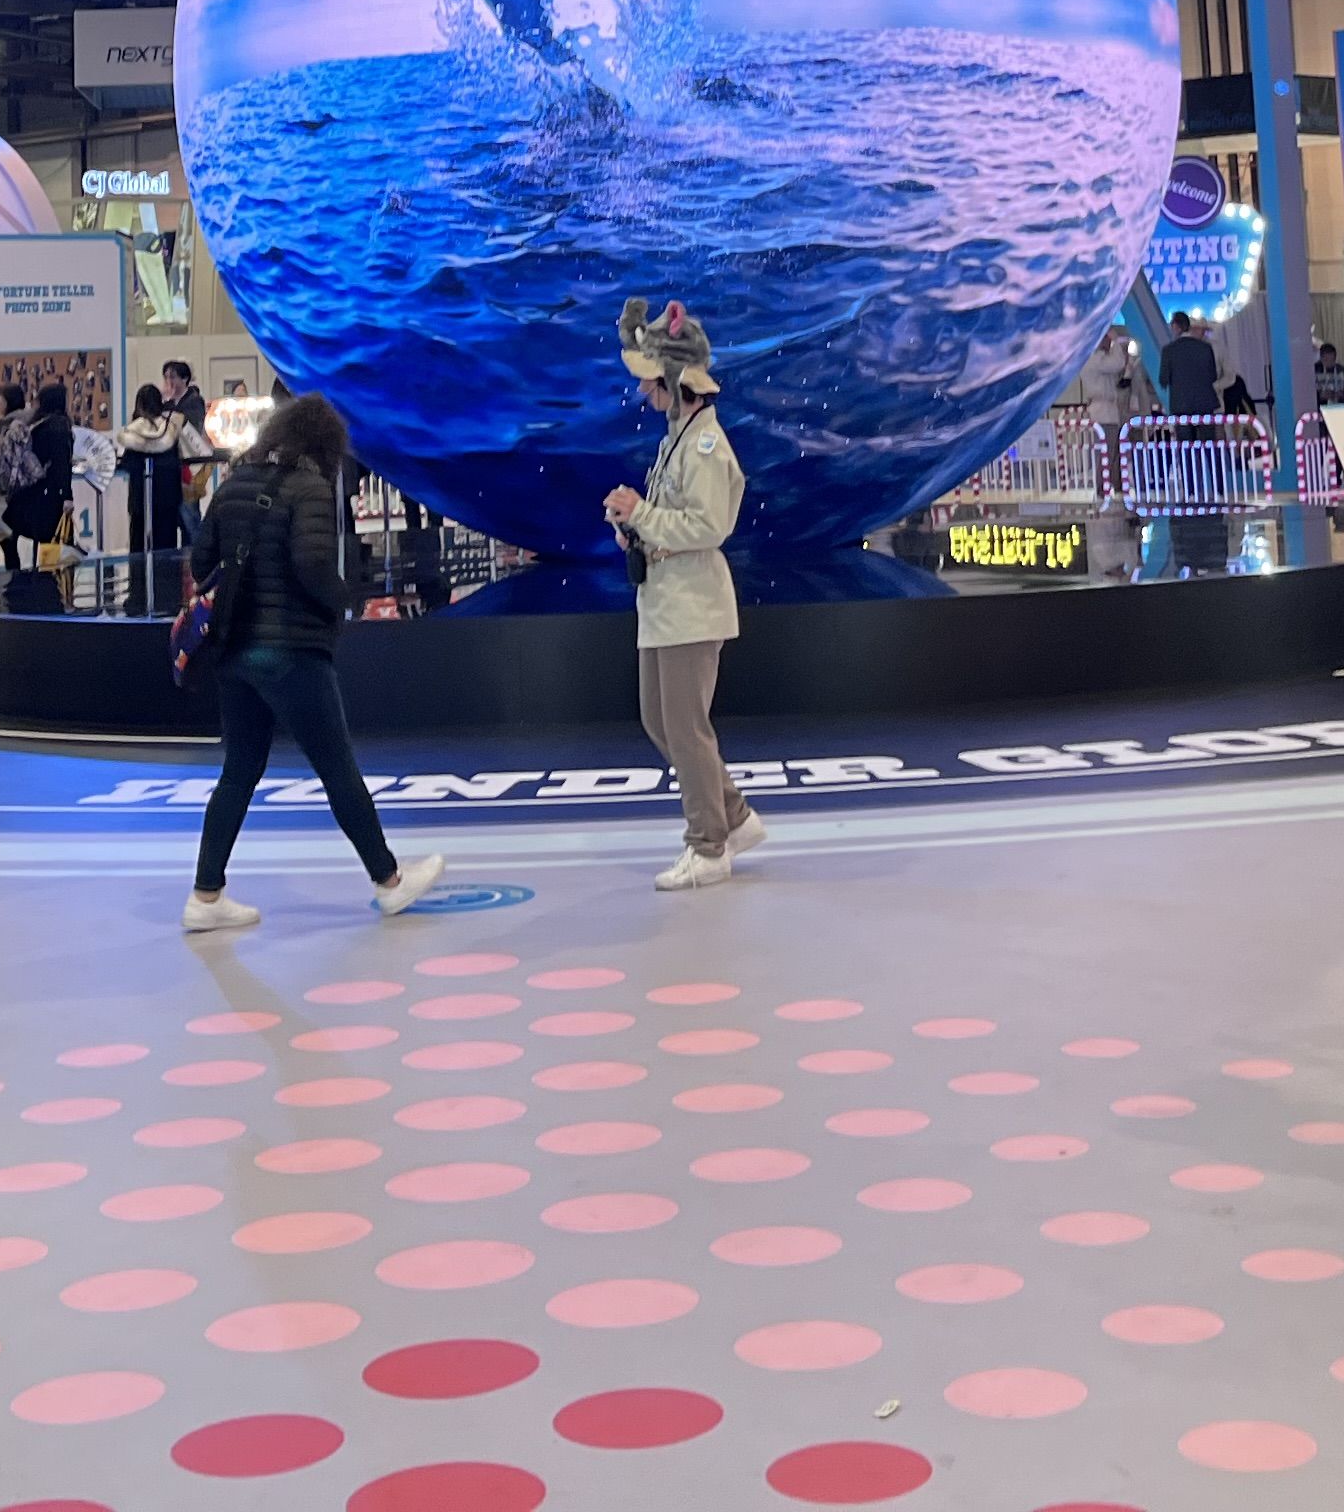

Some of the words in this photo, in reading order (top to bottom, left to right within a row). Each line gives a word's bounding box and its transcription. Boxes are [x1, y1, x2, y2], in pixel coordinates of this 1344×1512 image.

[82, 170, 107, 198] CJ
[108, 170, 170, 195] Global
[51, 284, 95, 297] TELLER
[4, 301, 39, 314] PHOTO
[41, 301, 72, 313] ZONE
[79, 507, 93, 537] 1
